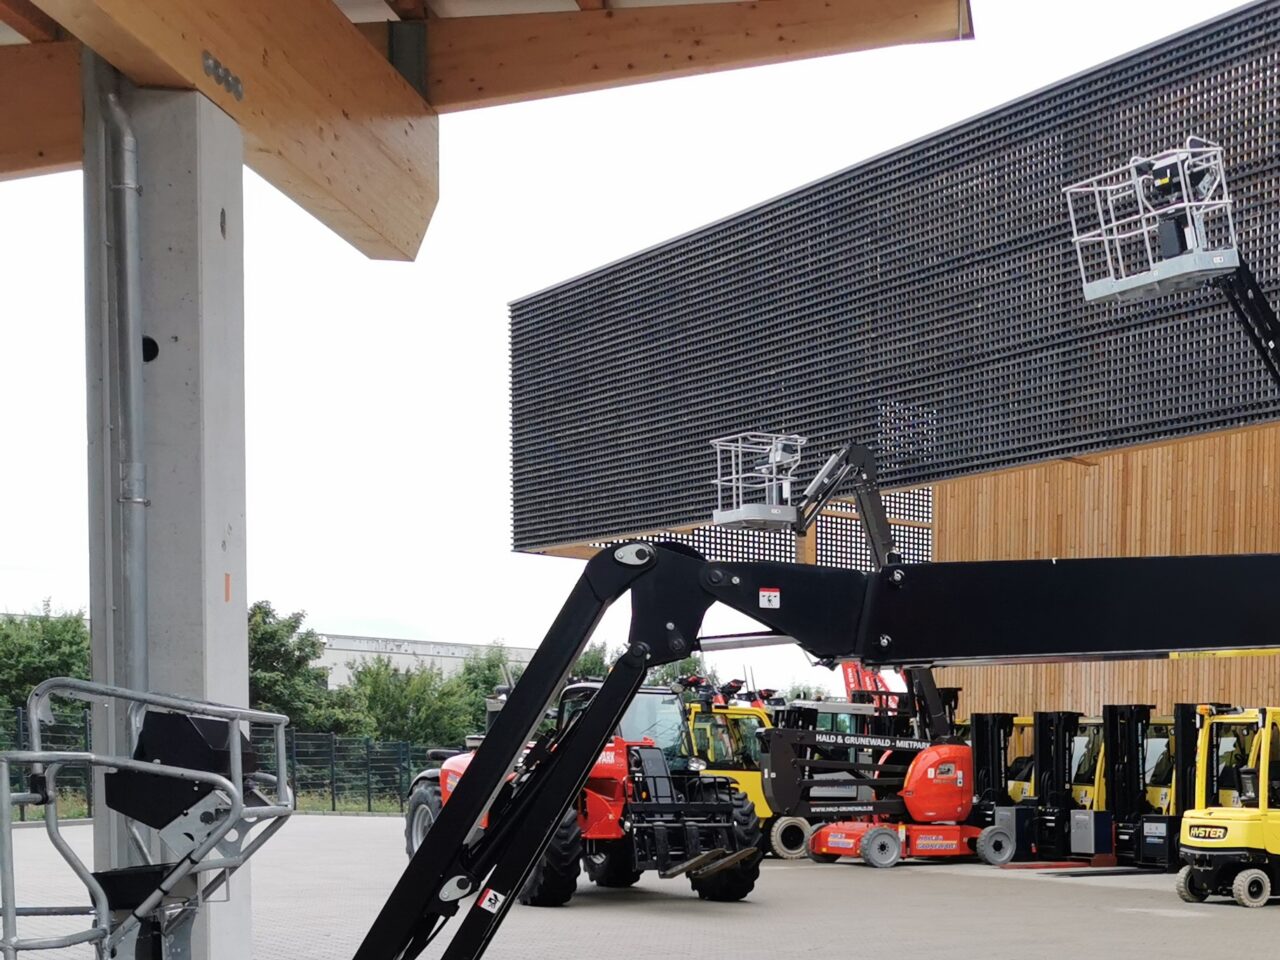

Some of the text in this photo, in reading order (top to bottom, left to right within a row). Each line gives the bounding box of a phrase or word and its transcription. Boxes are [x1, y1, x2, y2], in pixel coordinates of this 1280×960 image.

[816, 734, 835, 743] HALD
[837, 735, 843, 744] &
[844, 736, 890, 747] GRUNEWALD
[1190, 827, 1225, 839] HYSTER
